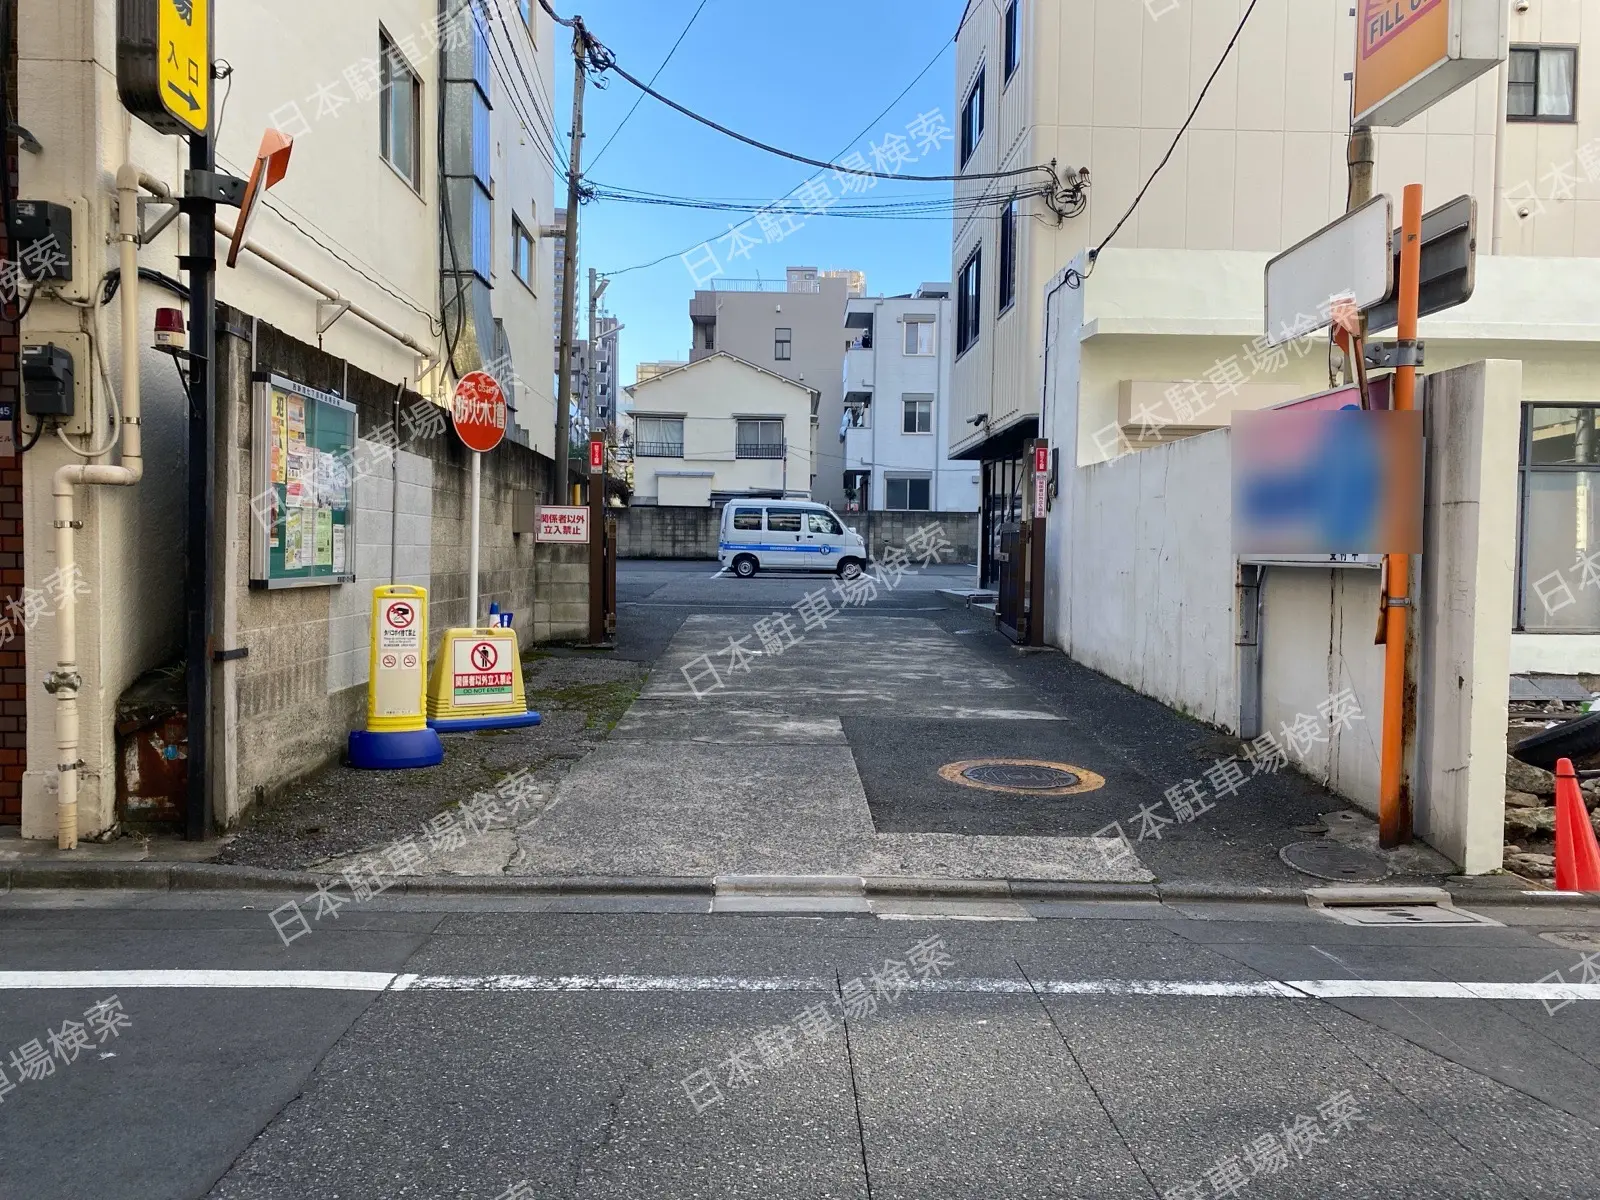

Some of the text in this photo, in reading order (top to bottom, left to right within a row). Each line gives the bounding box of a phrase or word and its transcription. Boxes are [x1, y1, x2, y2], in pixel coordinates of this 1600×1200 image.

[1370, 2, 1404, 44] FILL
[167, 40, 199, 87] 入口
[541, 514, 585, 524] 関係者以外
[543, 525, 581, 535] 立入禁止
[455, 674, 512, 687] 関係者以外立入禁止
